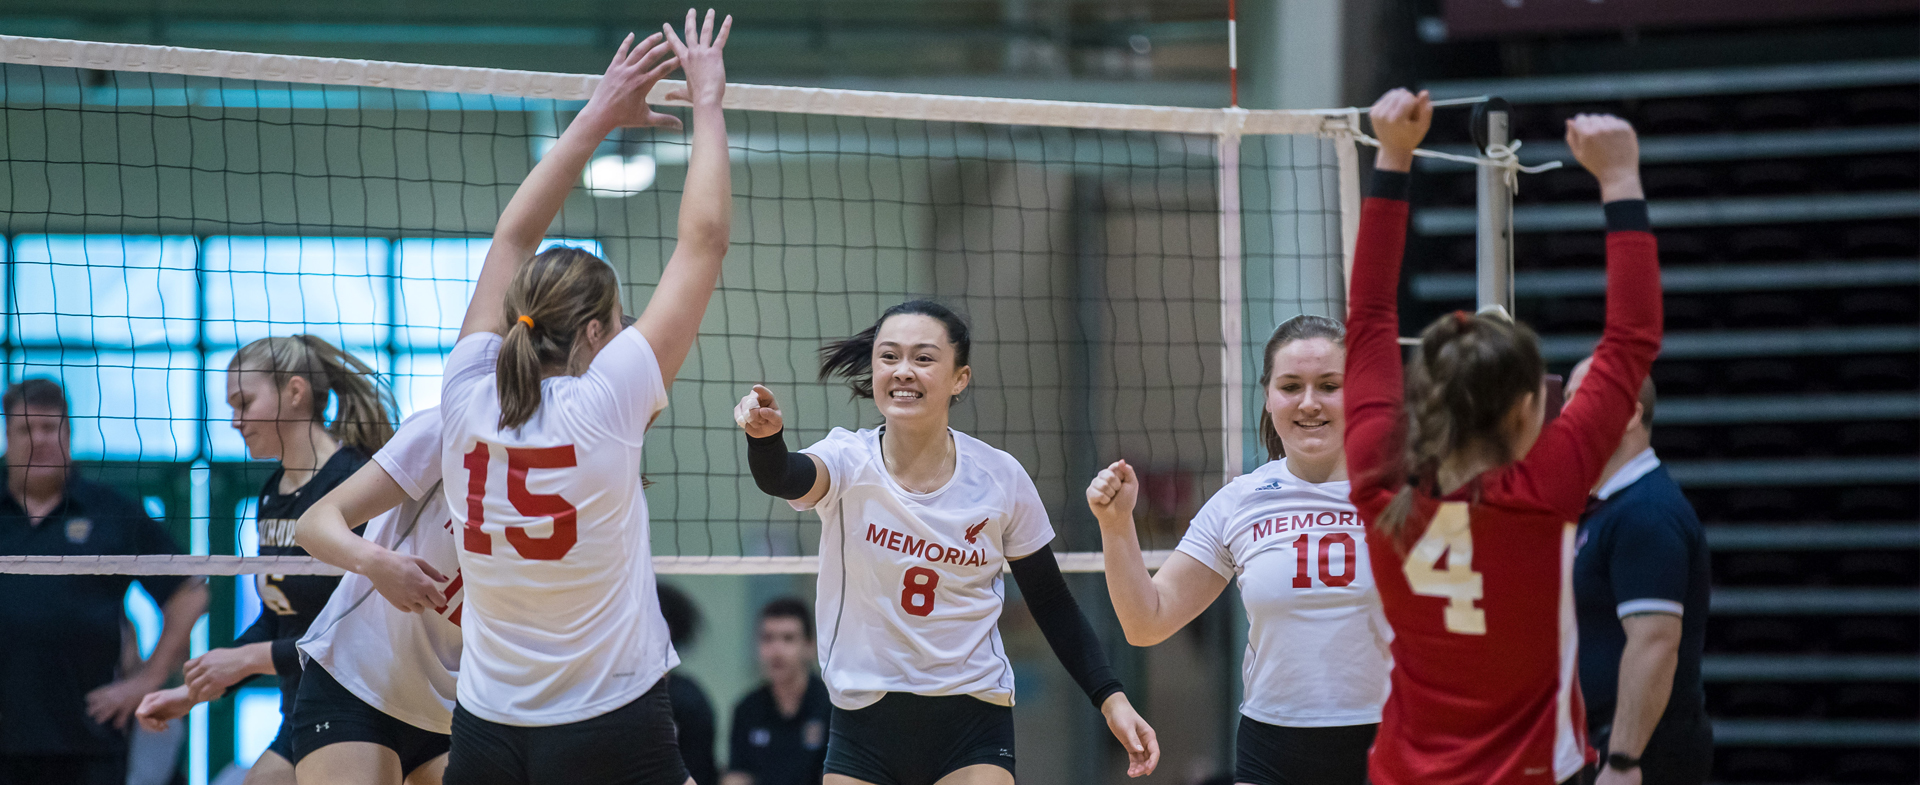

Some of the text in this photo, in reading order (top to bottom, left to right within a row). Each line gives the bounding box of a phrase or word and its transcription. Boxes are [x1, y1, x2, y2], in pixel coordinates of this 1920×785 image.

[463, 441, 578, 561] 15
[1253, 511, 1365, 543] MEMORI
[865, 523, 989, 567] MEMORIAL
[1292, 532, 1357, 589] 10
[1402, 501, 1487, 635] 4
[900, 565, 940, 618] 8
